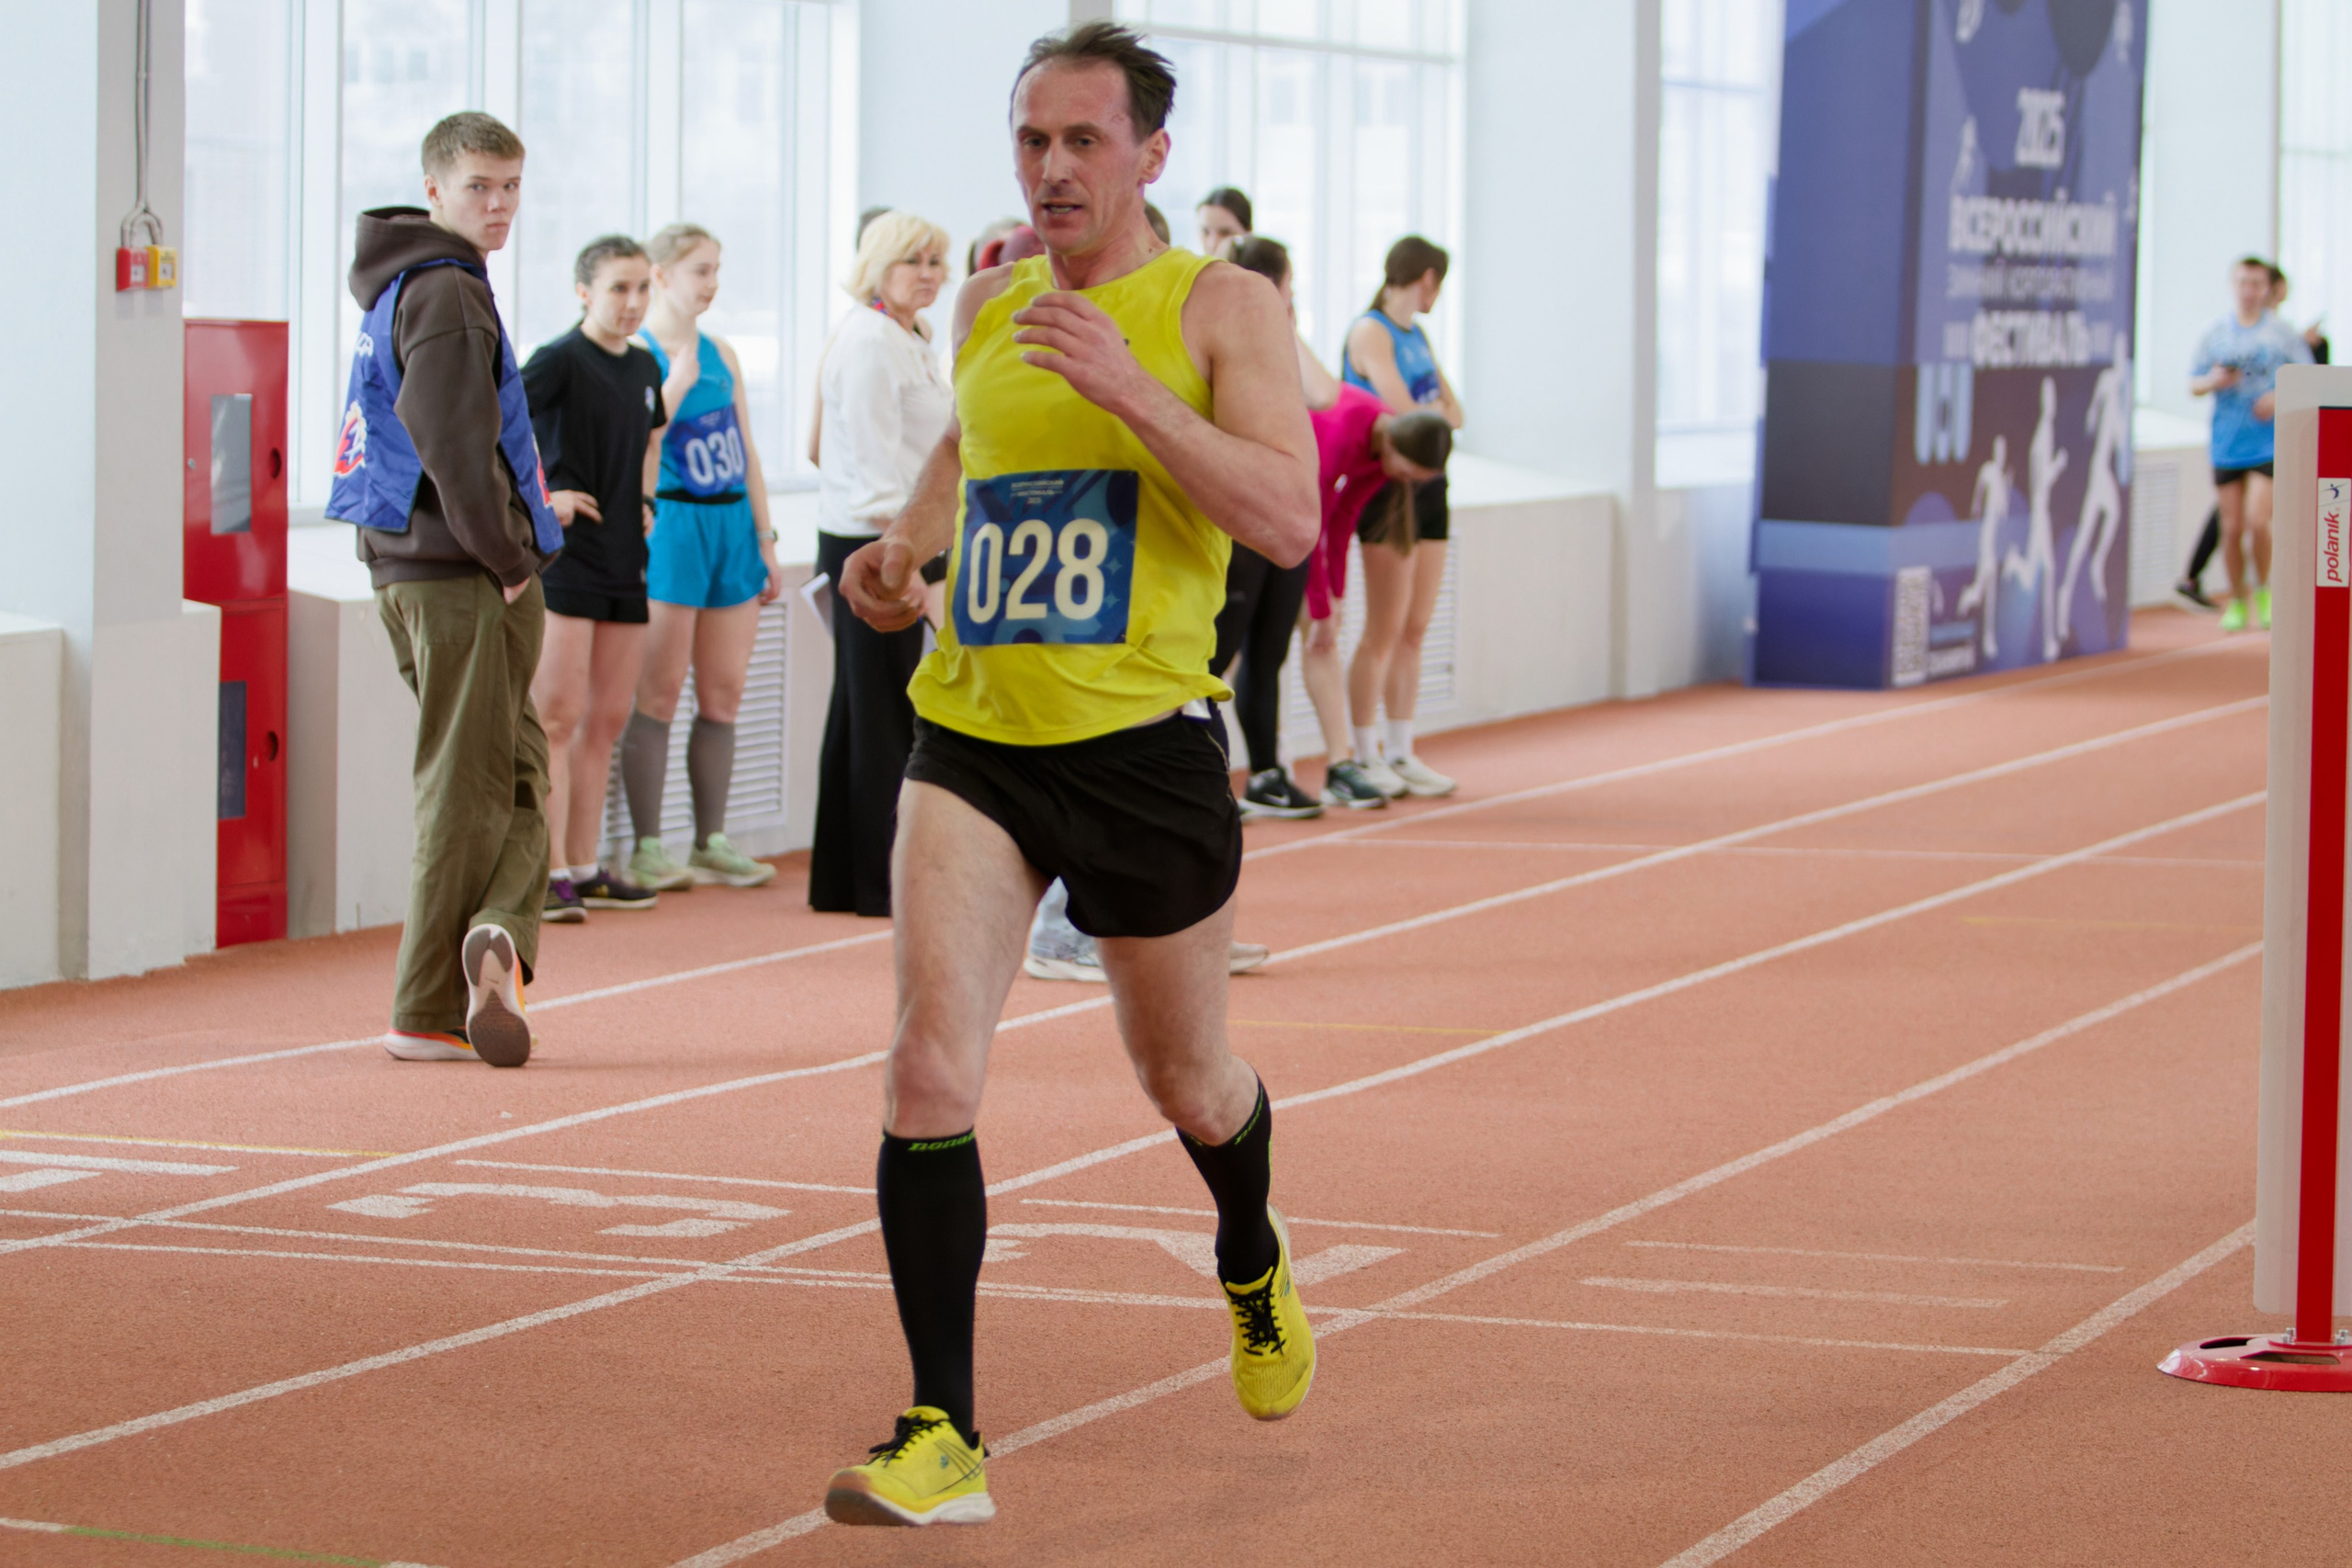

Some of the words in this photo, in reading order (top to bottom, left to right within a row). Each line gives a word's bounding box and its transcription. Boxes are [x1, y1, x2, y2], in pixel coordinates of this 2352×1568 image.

[685, 426, 745, 486] 030
[967, 518, 1108, 624] 028
[2323, 511, 2343, 583] polanik
